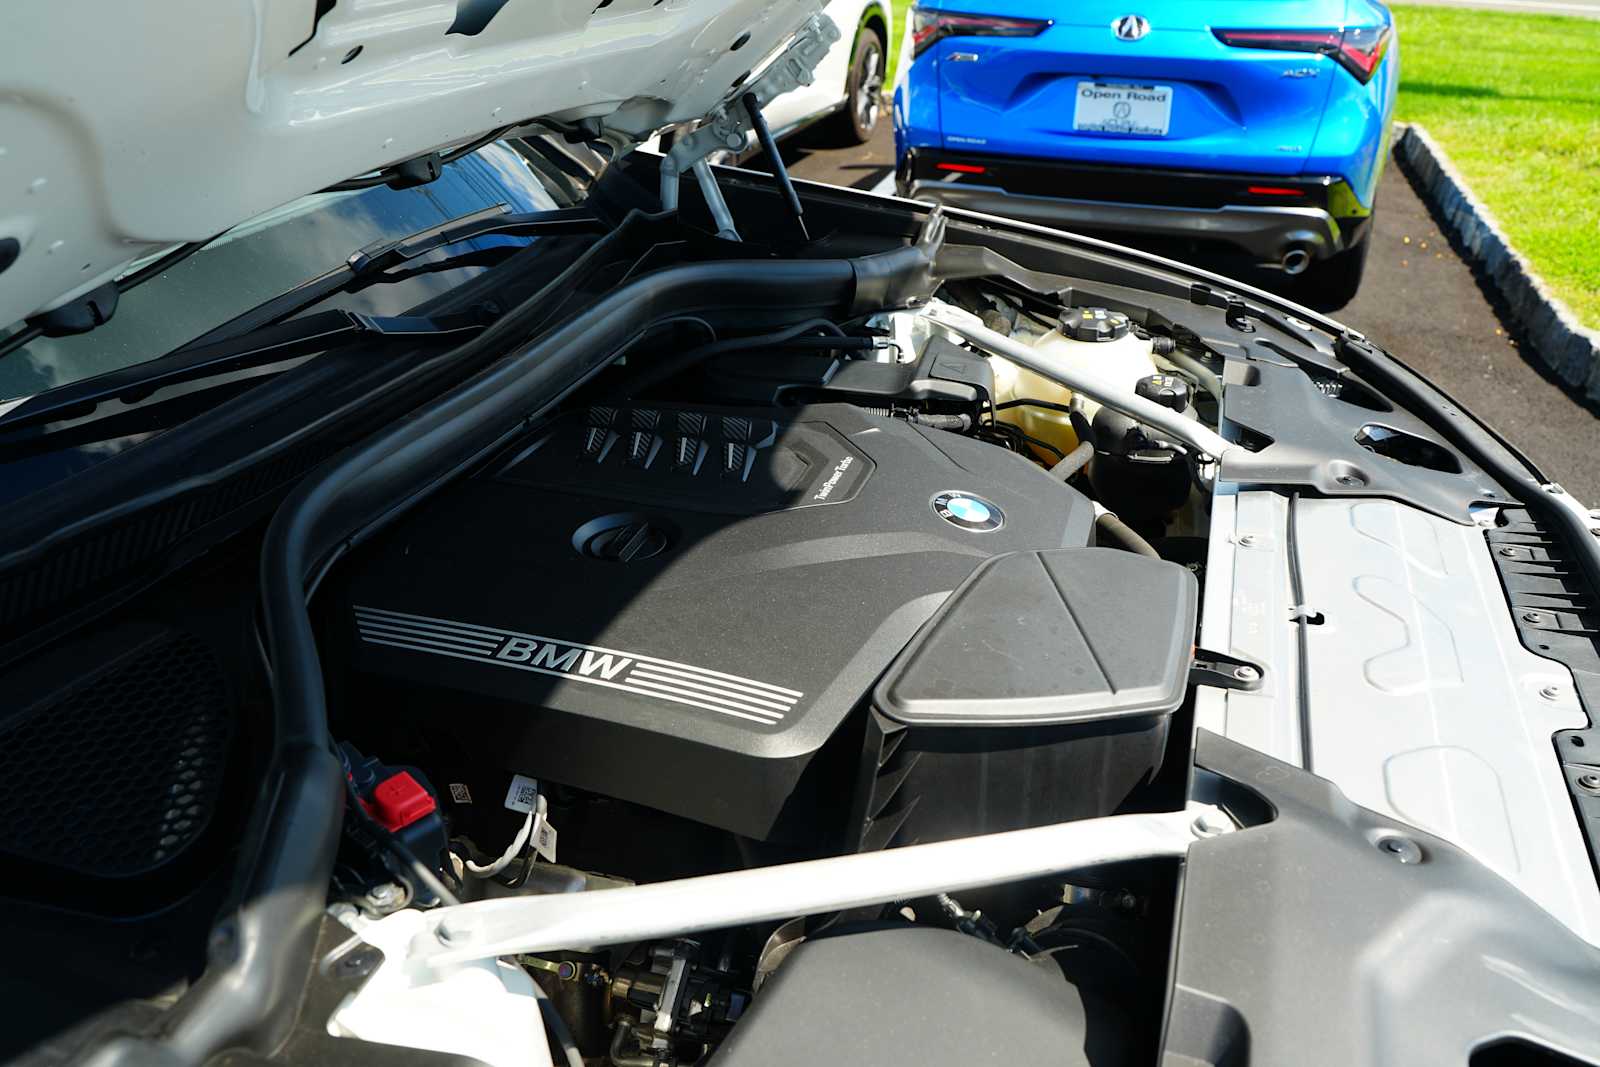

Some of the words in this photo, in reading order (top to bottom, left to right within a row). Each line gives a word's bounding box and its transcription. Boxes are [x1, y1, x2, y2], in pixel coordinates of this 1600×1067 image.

[1081, 88, 1121, 99] Open
[1127, 92, 1167, 103] Road
[813, 470, 844, 501] TwinPower
[834, 456, 854, 471] Turbo
[495, 637, 633, 680] BMW
